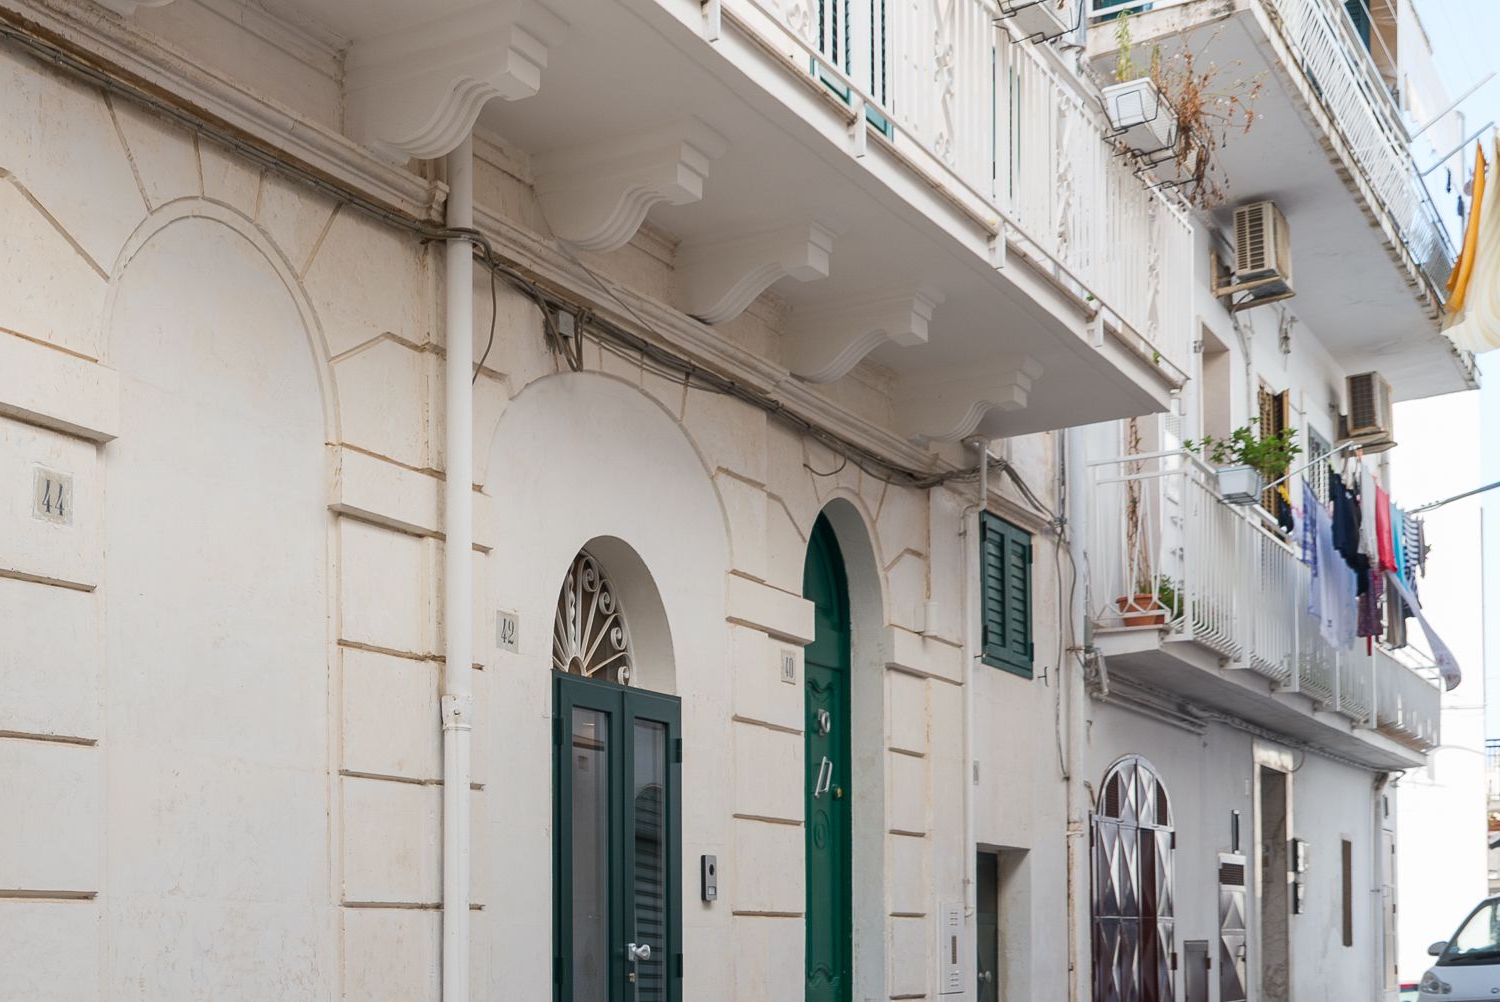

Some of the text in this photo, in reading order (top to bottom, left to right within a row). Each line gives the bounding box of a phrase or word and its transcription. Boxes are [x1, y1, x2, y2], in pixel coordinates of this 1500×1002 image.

[41, 478, 66, 517] 44
[500, 617, 515, 645] 42
[784, 656, 795, 679] 40
